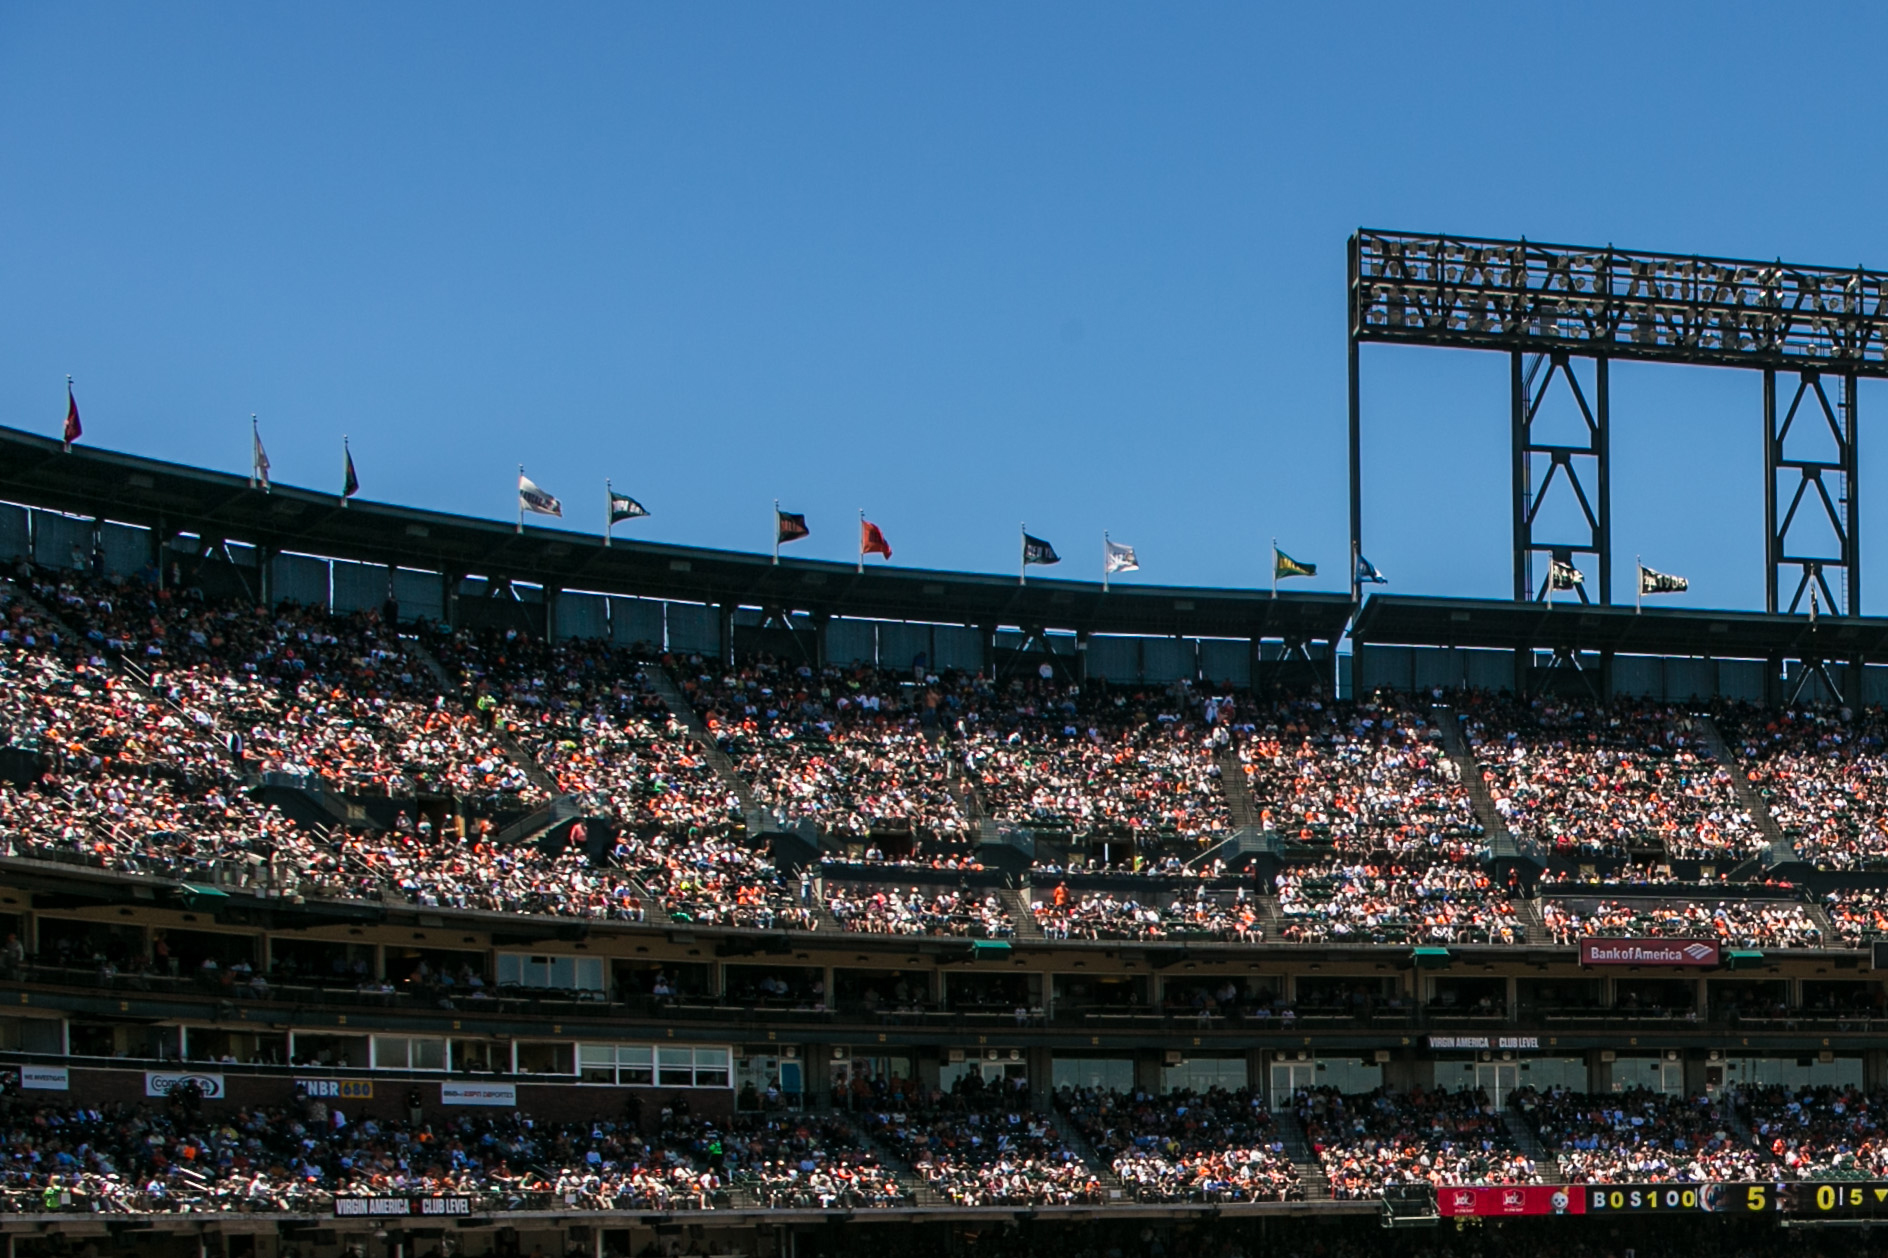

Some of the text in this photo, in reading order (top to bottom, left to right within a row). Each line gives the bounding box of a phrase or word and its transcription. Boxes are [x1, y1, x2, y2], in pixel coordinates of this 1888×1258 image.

[1591, 947, 1682, 960] Bank of America
[1429, 1037, 1539, 1048] VIRGIN AMERICA CLUB LEVEL
[343, 1082, 371, 1097] 680
[1593, 1191, 1606, 1208] B
[1630, 1191, 1642, 1208] S
[1646, 1191, 1658, 1208] 1
[1747, 1186, 1766, 1211] 5
[1816, 1185, 1835, 1211] 0
[1850, 1189, 1864, 1206] 5
[335, 1198, 469, 1215] VIRGIN AMERICA CLUB LEVEL
